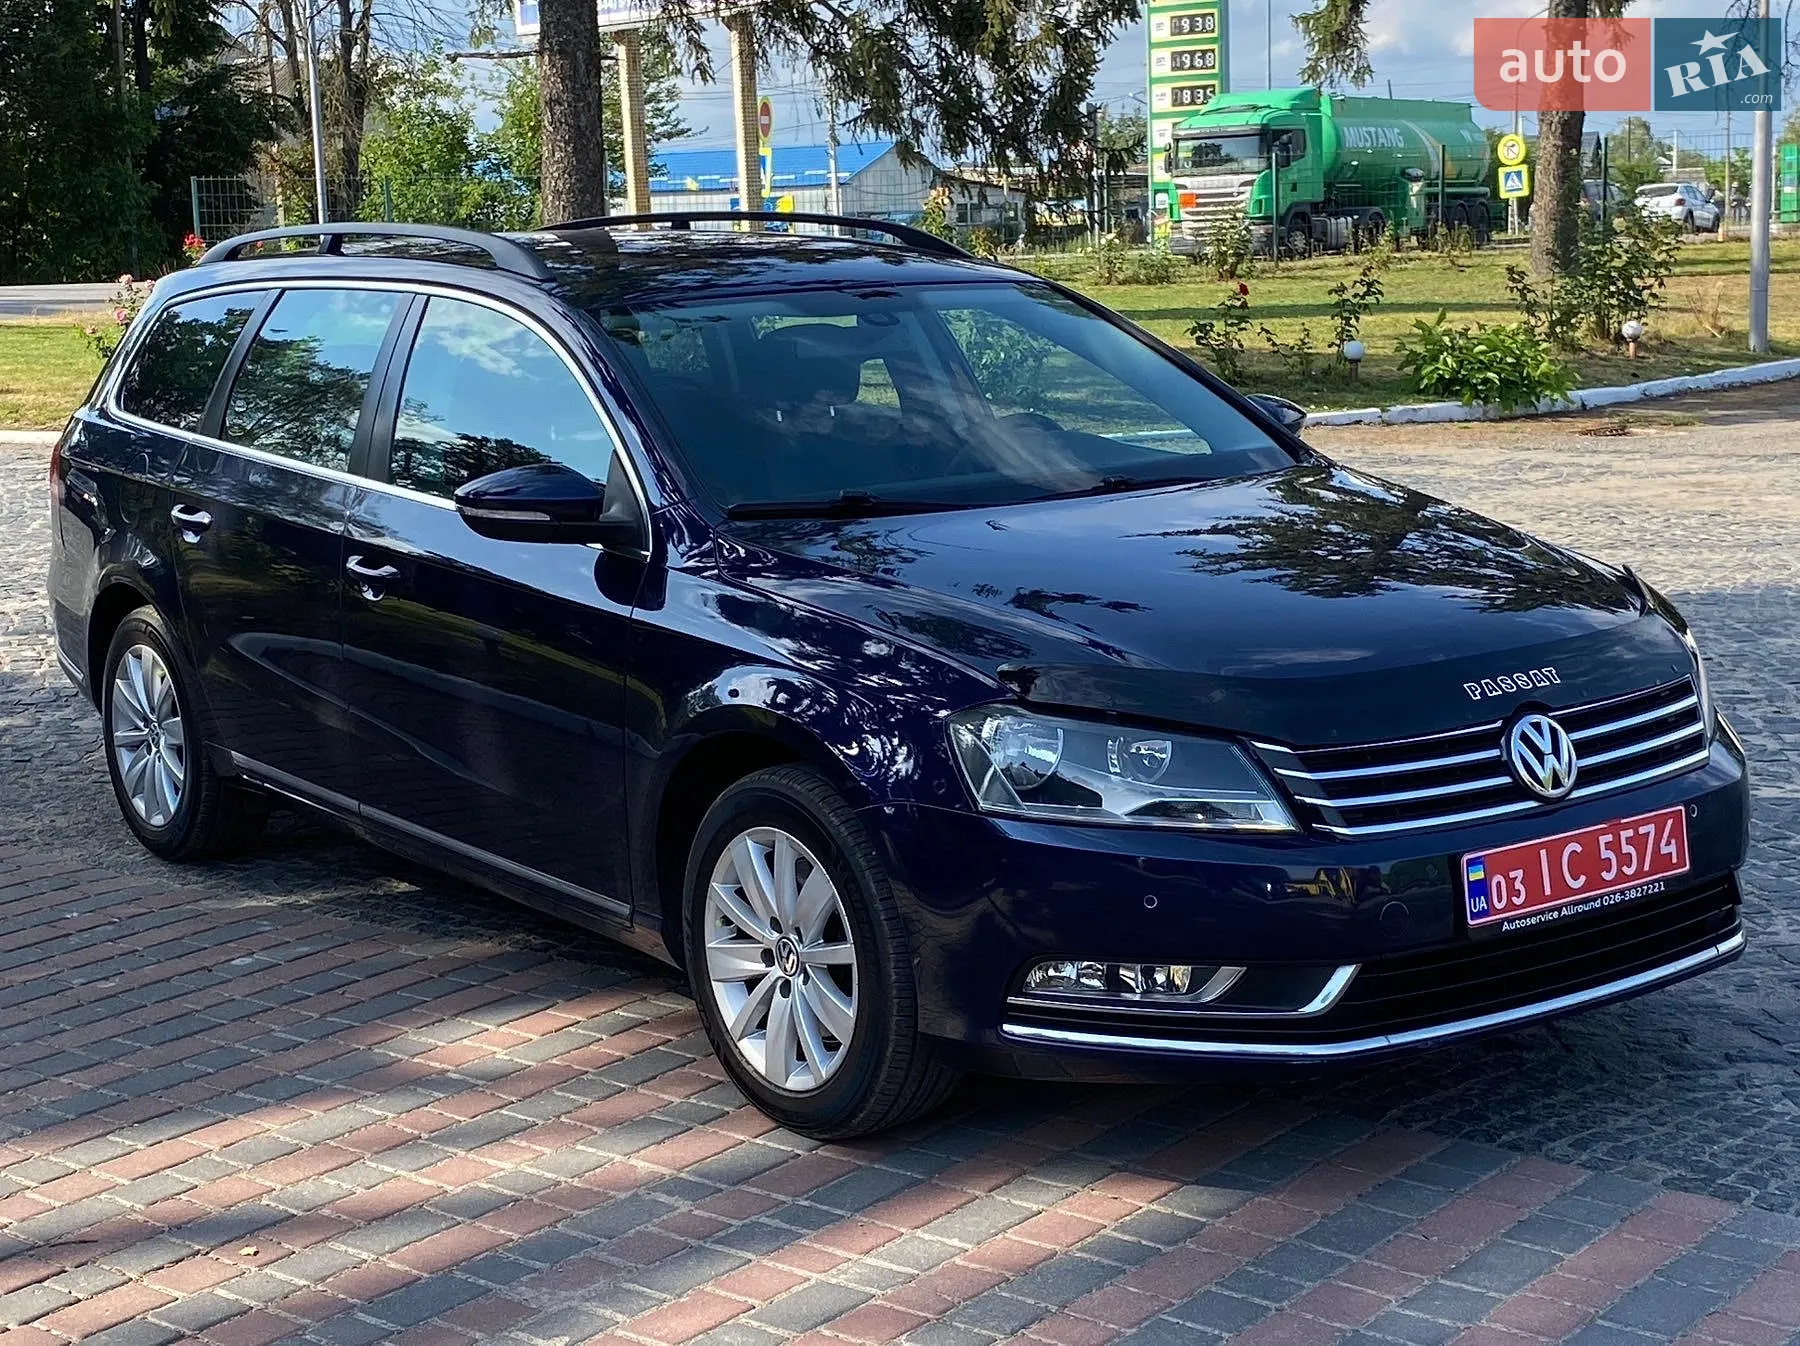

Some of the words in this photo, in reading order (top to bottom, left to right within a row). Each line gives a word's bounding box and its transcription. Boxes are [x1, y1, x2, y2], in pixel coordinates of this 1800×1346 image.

[1343, 126, 1405, 148] MUSTANG
[1463, 667, 1561, 700] PASSAT
[1511, 714, 1577, 798] VW
[1470, 897, 1487, 913] UA
[1490, 868, 1527, 910] 03
[1539, 842, 1587, 896] IC
[1598, 818, 1678, 882] 5574
[1502, 910, 1559, 932] Autoservice
[1560, 897, 1601, 917] Allround
[1602, 881, 1666, 906] 026-3827221
